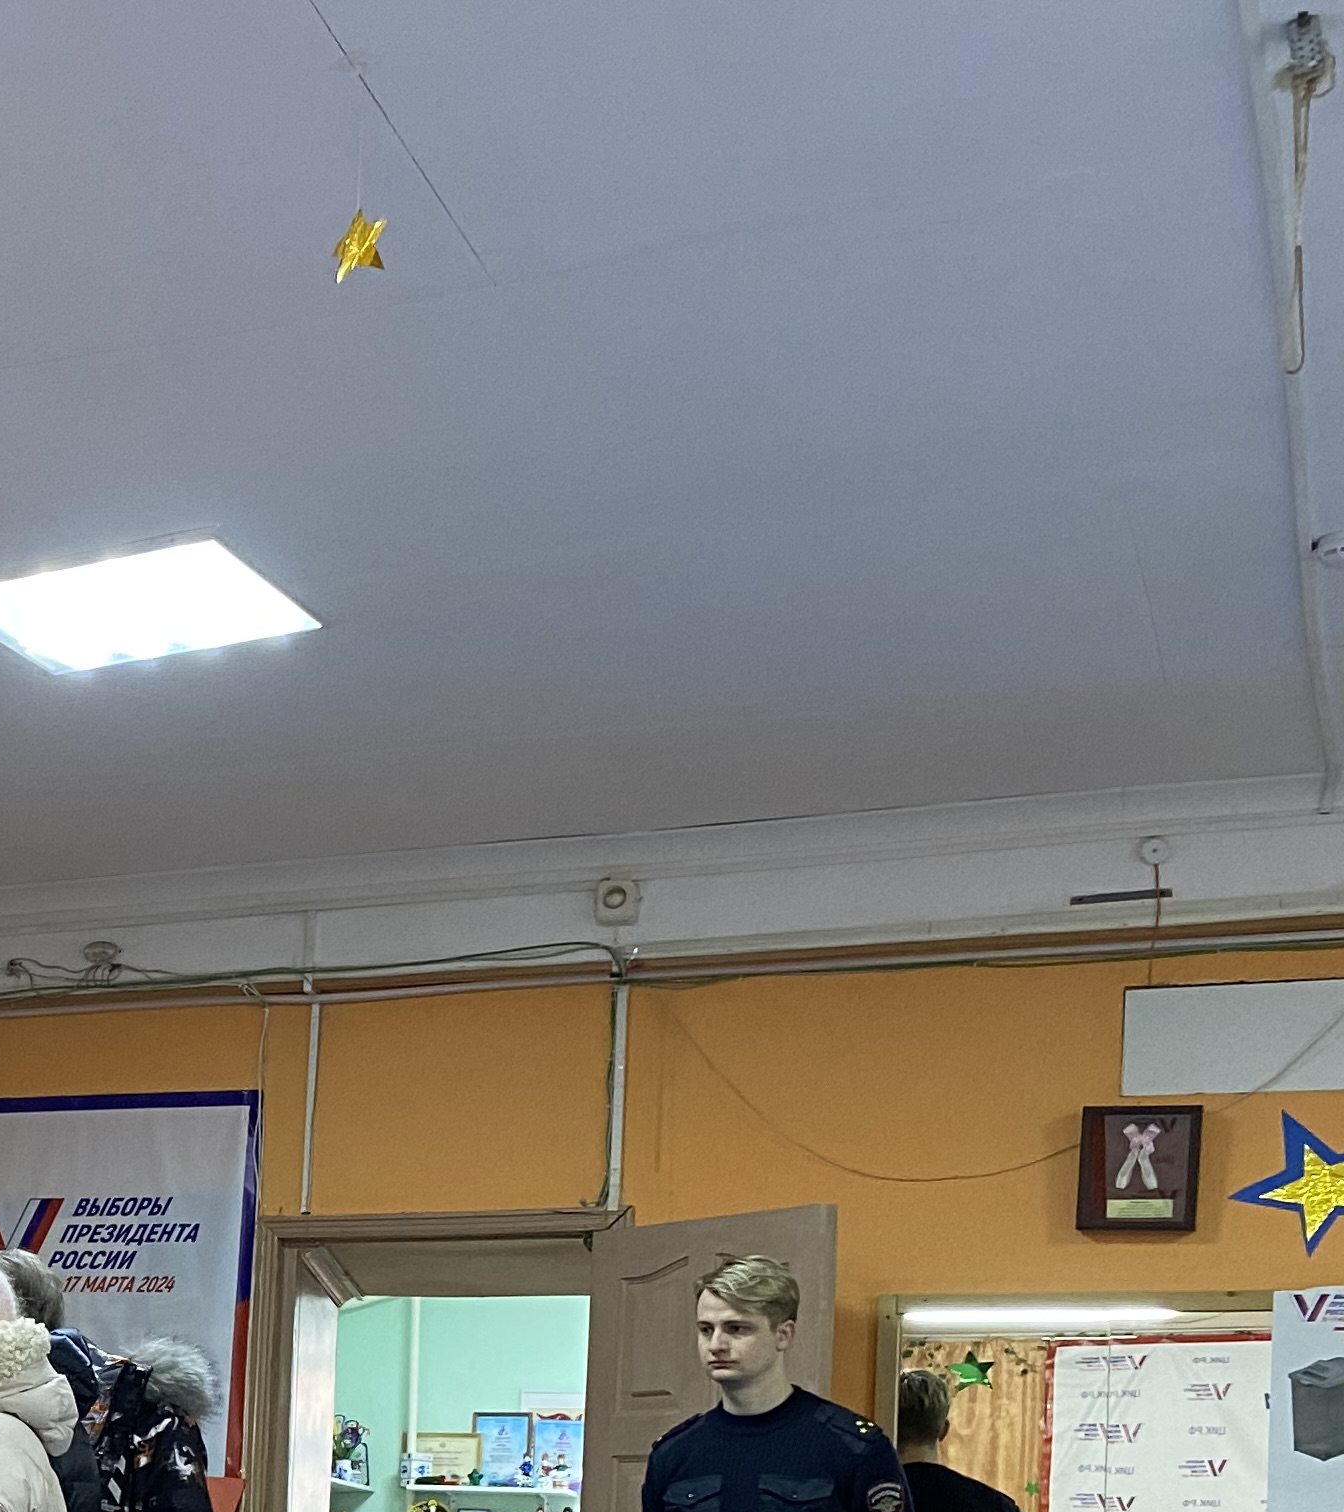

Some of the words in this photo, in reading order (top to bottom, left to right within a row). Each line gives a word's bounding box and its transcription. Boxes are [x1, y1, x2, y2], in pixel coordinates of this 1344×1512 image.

[72, 1196, 174, 1217] ВЫБОРЫ
[60, 1223, 201, 1246] ПРЕЗИДЕНТА
[47, 1250, 138, 1270] РОССИИ
[81, 1275, 136, 1293] МАРТА
[136, 1275, 176, 1293] 2024
